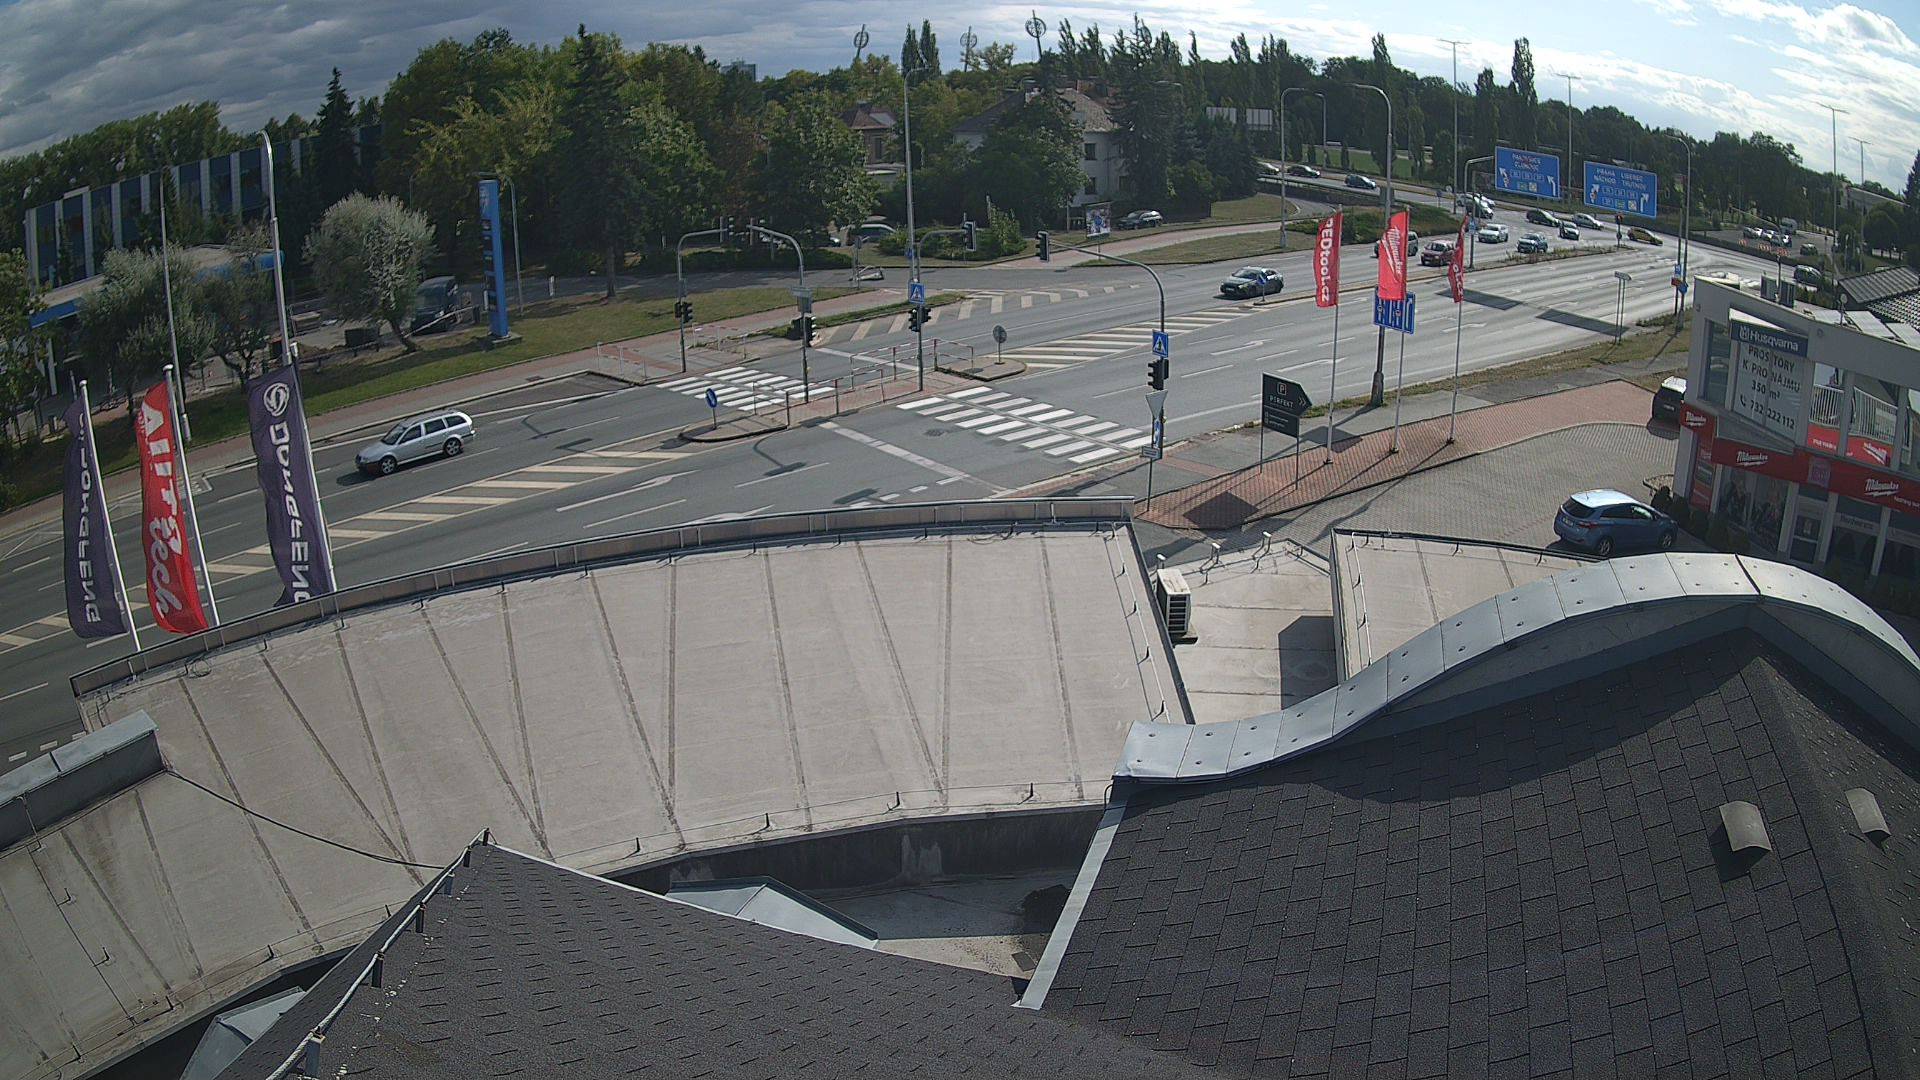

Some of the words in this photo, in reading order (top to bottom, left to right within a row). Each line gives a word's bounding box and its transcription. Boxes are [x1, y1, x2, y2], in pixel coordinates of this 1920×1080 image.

[1750, 330, 1799, 352] Husqvarna
[1751, 380, 1766, 394] 350
[1269, 394, 1294, 408] PERFEKT
